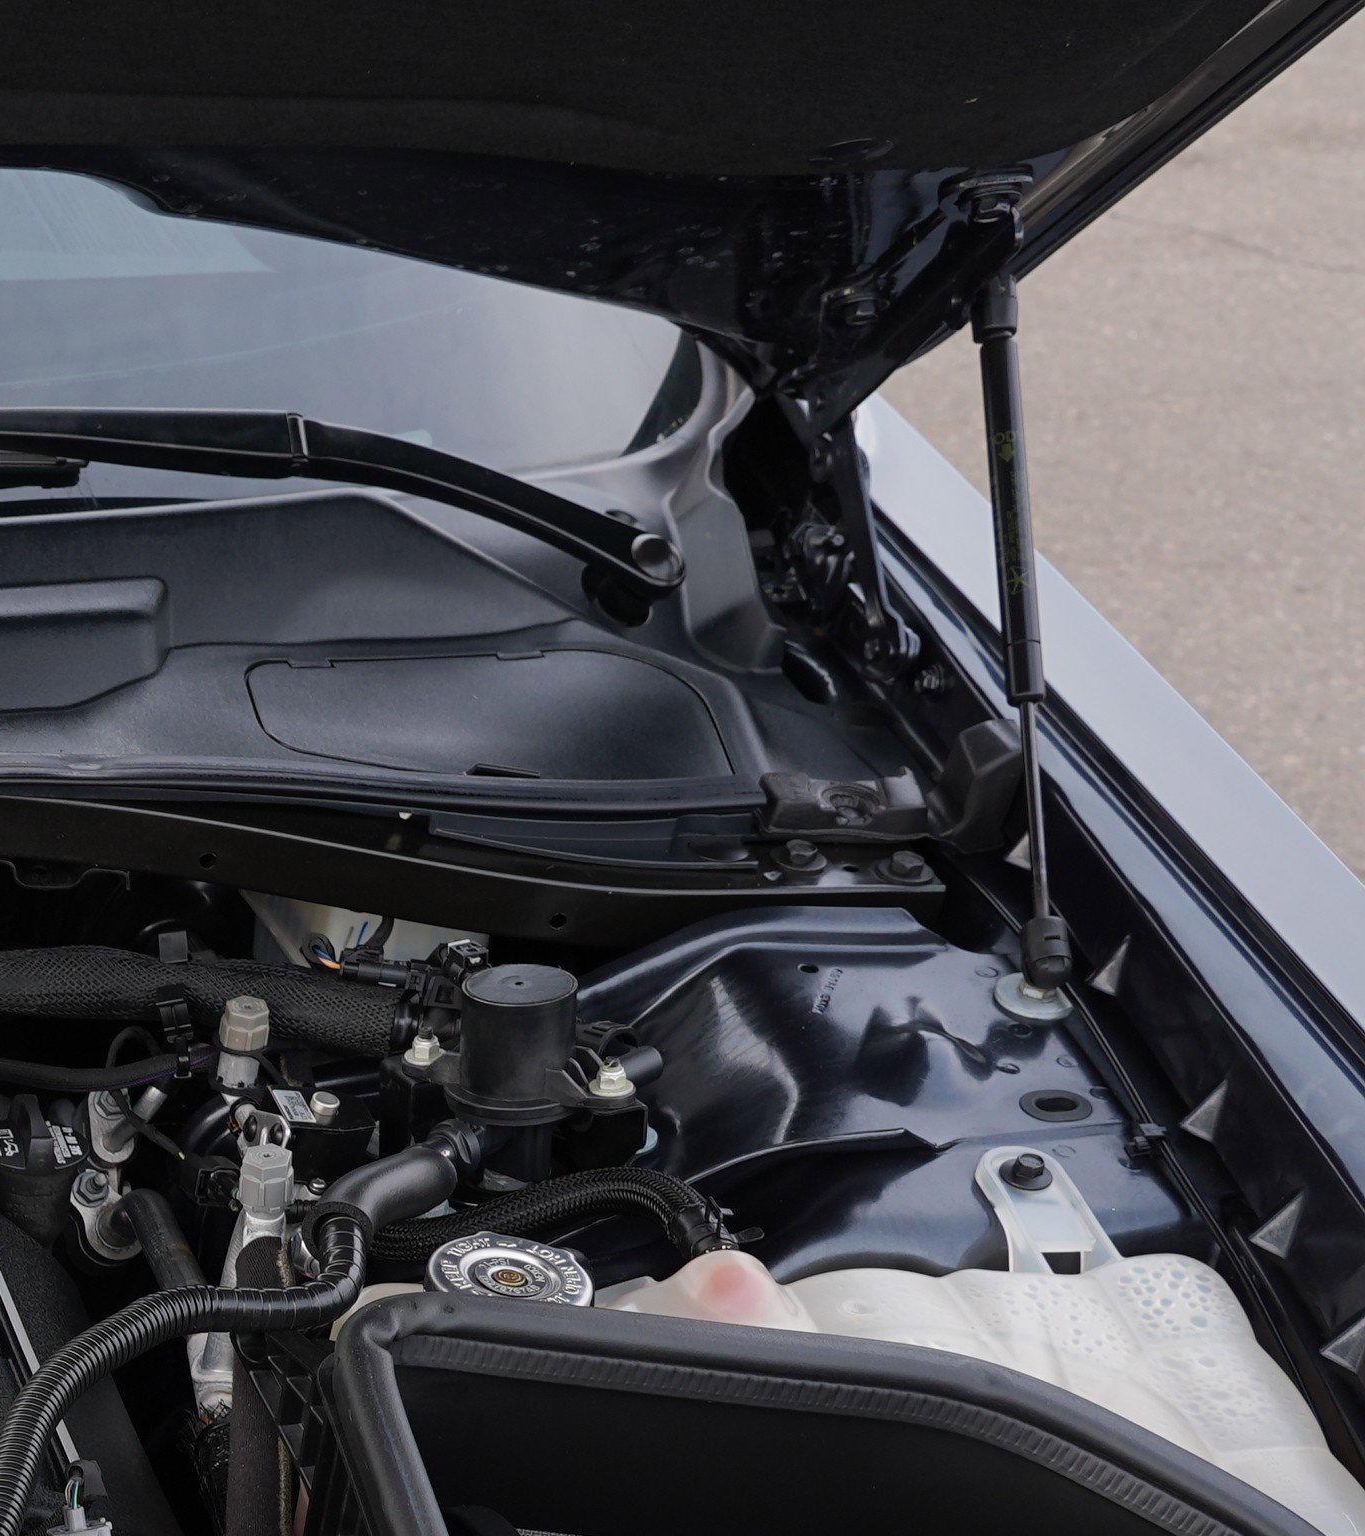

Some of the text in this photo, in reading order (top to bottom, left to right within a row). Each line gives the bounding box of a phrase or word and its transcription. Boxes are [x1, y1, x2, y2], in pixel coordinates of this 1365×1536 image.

[440, 1238, 491, 1290] KEEP TIGHT
[526, 1245, 567, 1266] HOT
[561, 1266, 582, 1295] OPEN
